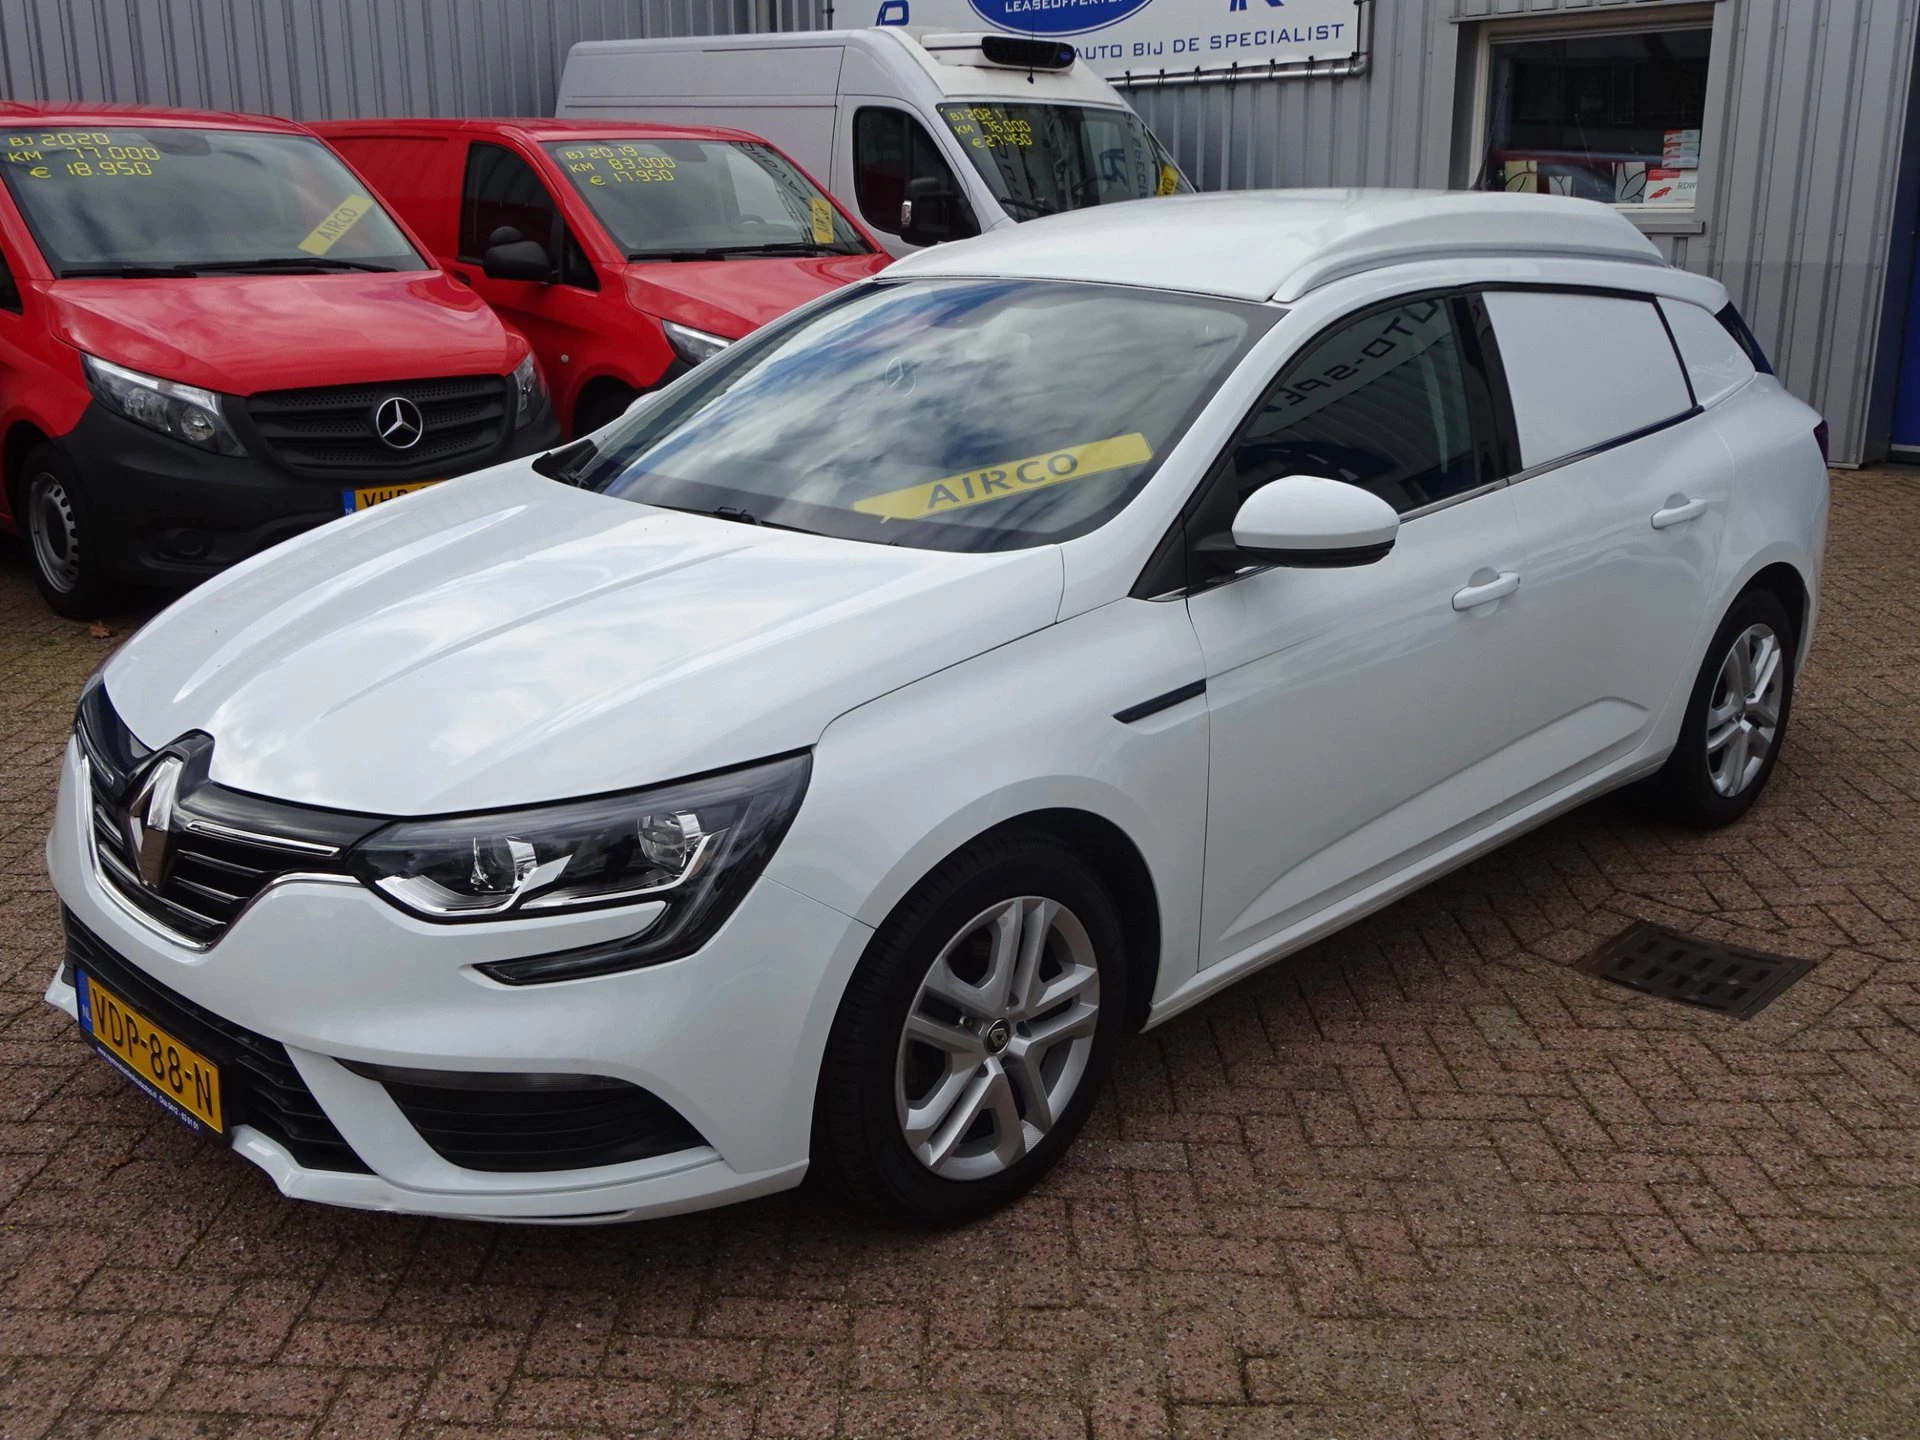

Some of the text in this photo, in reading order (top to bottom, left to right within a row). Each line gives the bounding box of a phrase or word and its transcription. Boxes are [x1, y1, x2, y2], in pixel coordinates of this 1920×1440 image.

[1074, 23, 1345, 60] AUTO BIJ DE SPECIALIST
[964, 108, 1002, 121] 2021
[953, 120, 1032, 136] KM 76.000
[8, 132, 111, 147] BJ 2020
[983, 133, 1033, 147] 27.450
[8, 147, 161, 162] KM 77.000
[587, 146, 638, 159] 2019
[29, 161, 153, 179] € 18.950
[569, 157, 676, 173] KM 83.000
[612, 169, 675, 183] 17.950
[316, 207, 358, 241] AIRCO
[926, 453, 1079, 509] AIRCO
[81, 1003, 92, 1022] NL
[92, 987, 214, 1118] VDP-88-N
